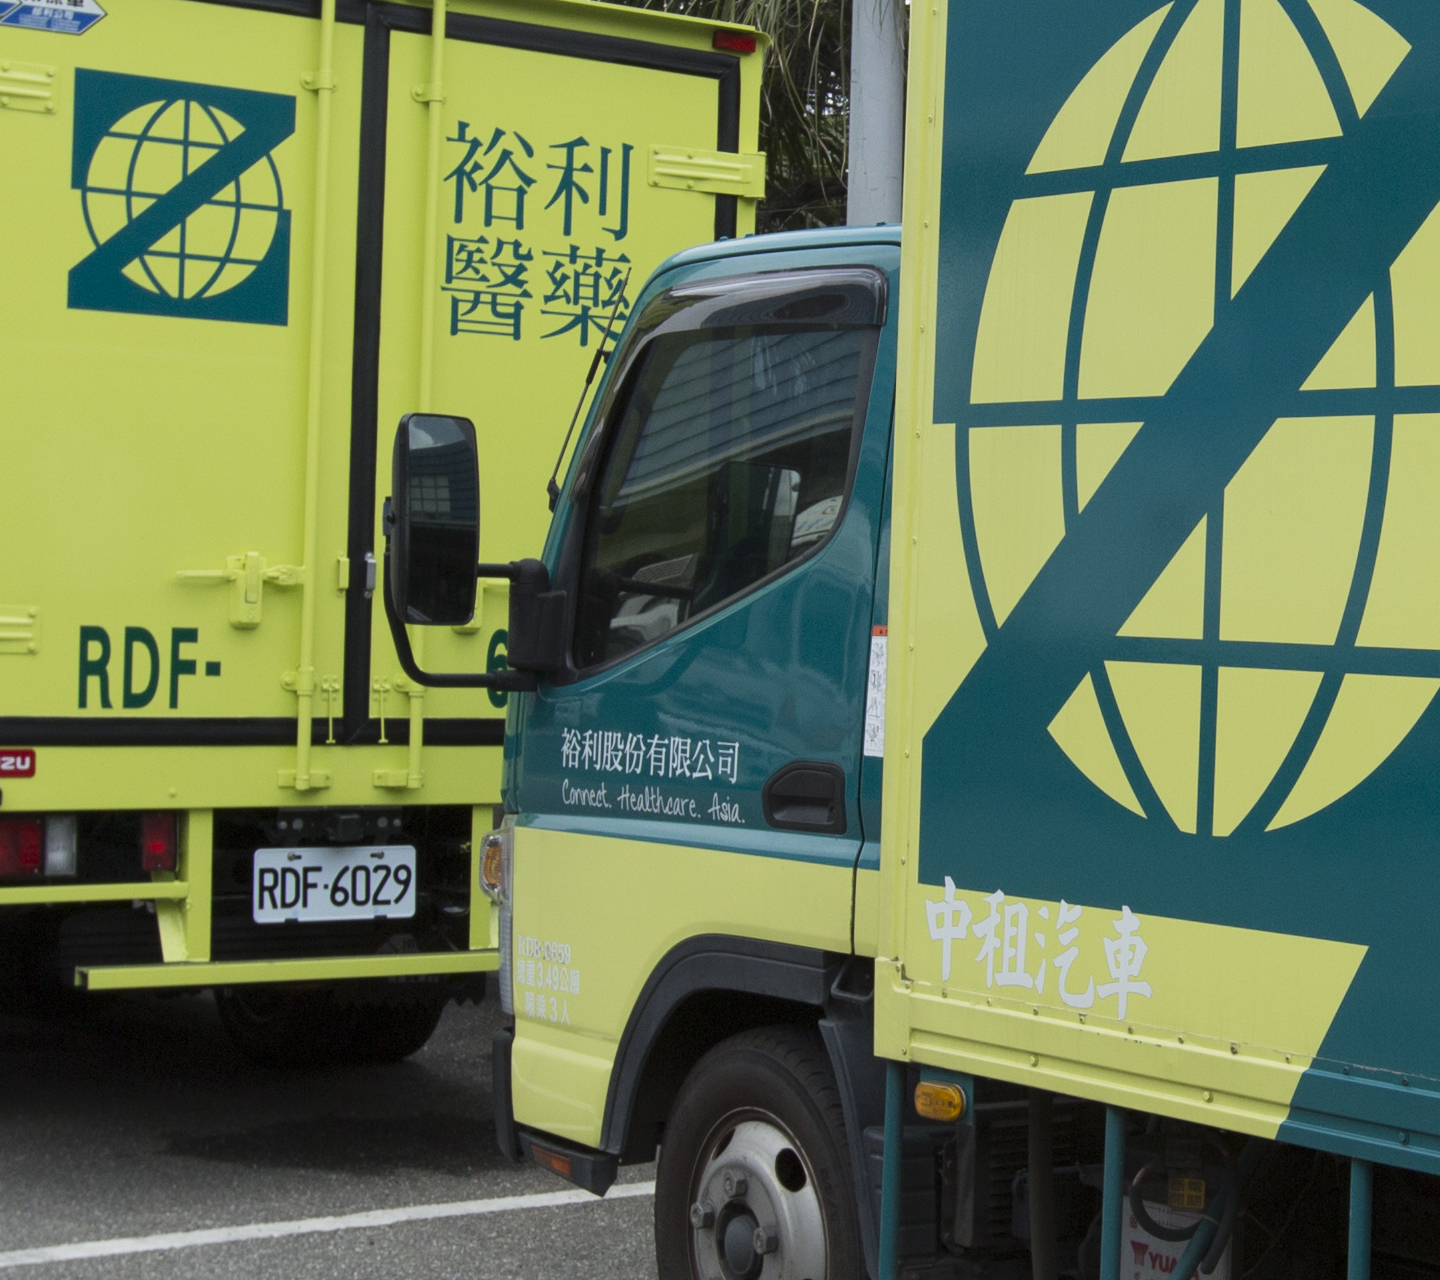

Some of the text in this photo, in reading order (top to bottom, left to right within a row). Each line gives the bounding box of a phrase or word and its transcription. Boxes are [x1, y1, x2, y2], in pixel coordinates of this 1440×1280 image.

[443, 120, 634, 241] 裕利
[441, 233, 631, 348] 醫藥
[78, 626, 221, 710] RDF-
[561, 727, 740, 784] 裕利股份有限公司
[562, 778, 746, 824] Connect. Healthcare. Asia.
[258, 864, 412, 910] RDF-6029
[518, 934, 572, 965] RDB-0659
[925, 876, 1153, 1021] 中租汽車
